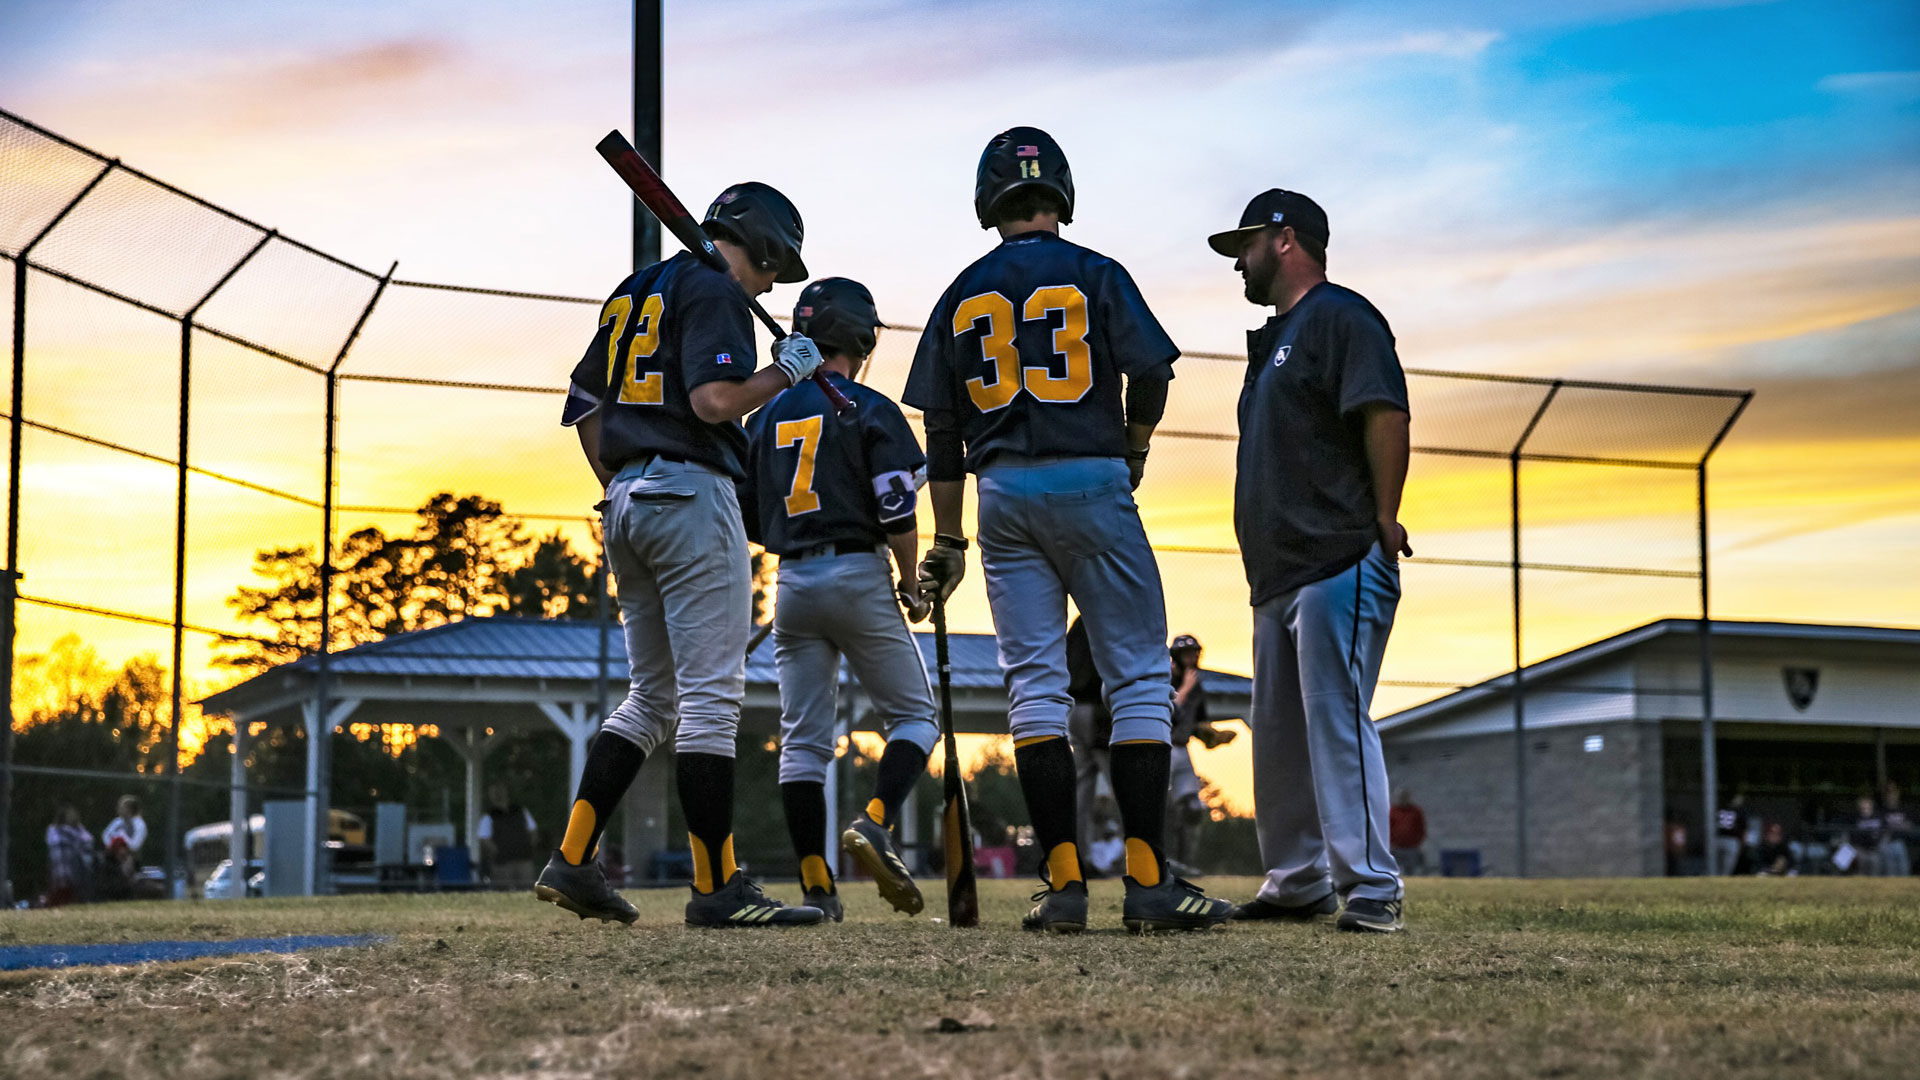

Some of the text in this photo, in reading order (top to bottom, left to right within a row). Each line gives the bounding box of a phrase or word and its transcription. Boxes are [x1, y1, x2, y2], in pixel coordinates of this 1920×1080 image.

[1020, 160, 1041, 179] 14
[952, 284, 1094, 414] 33
[776, 414, 824, 518] 7
